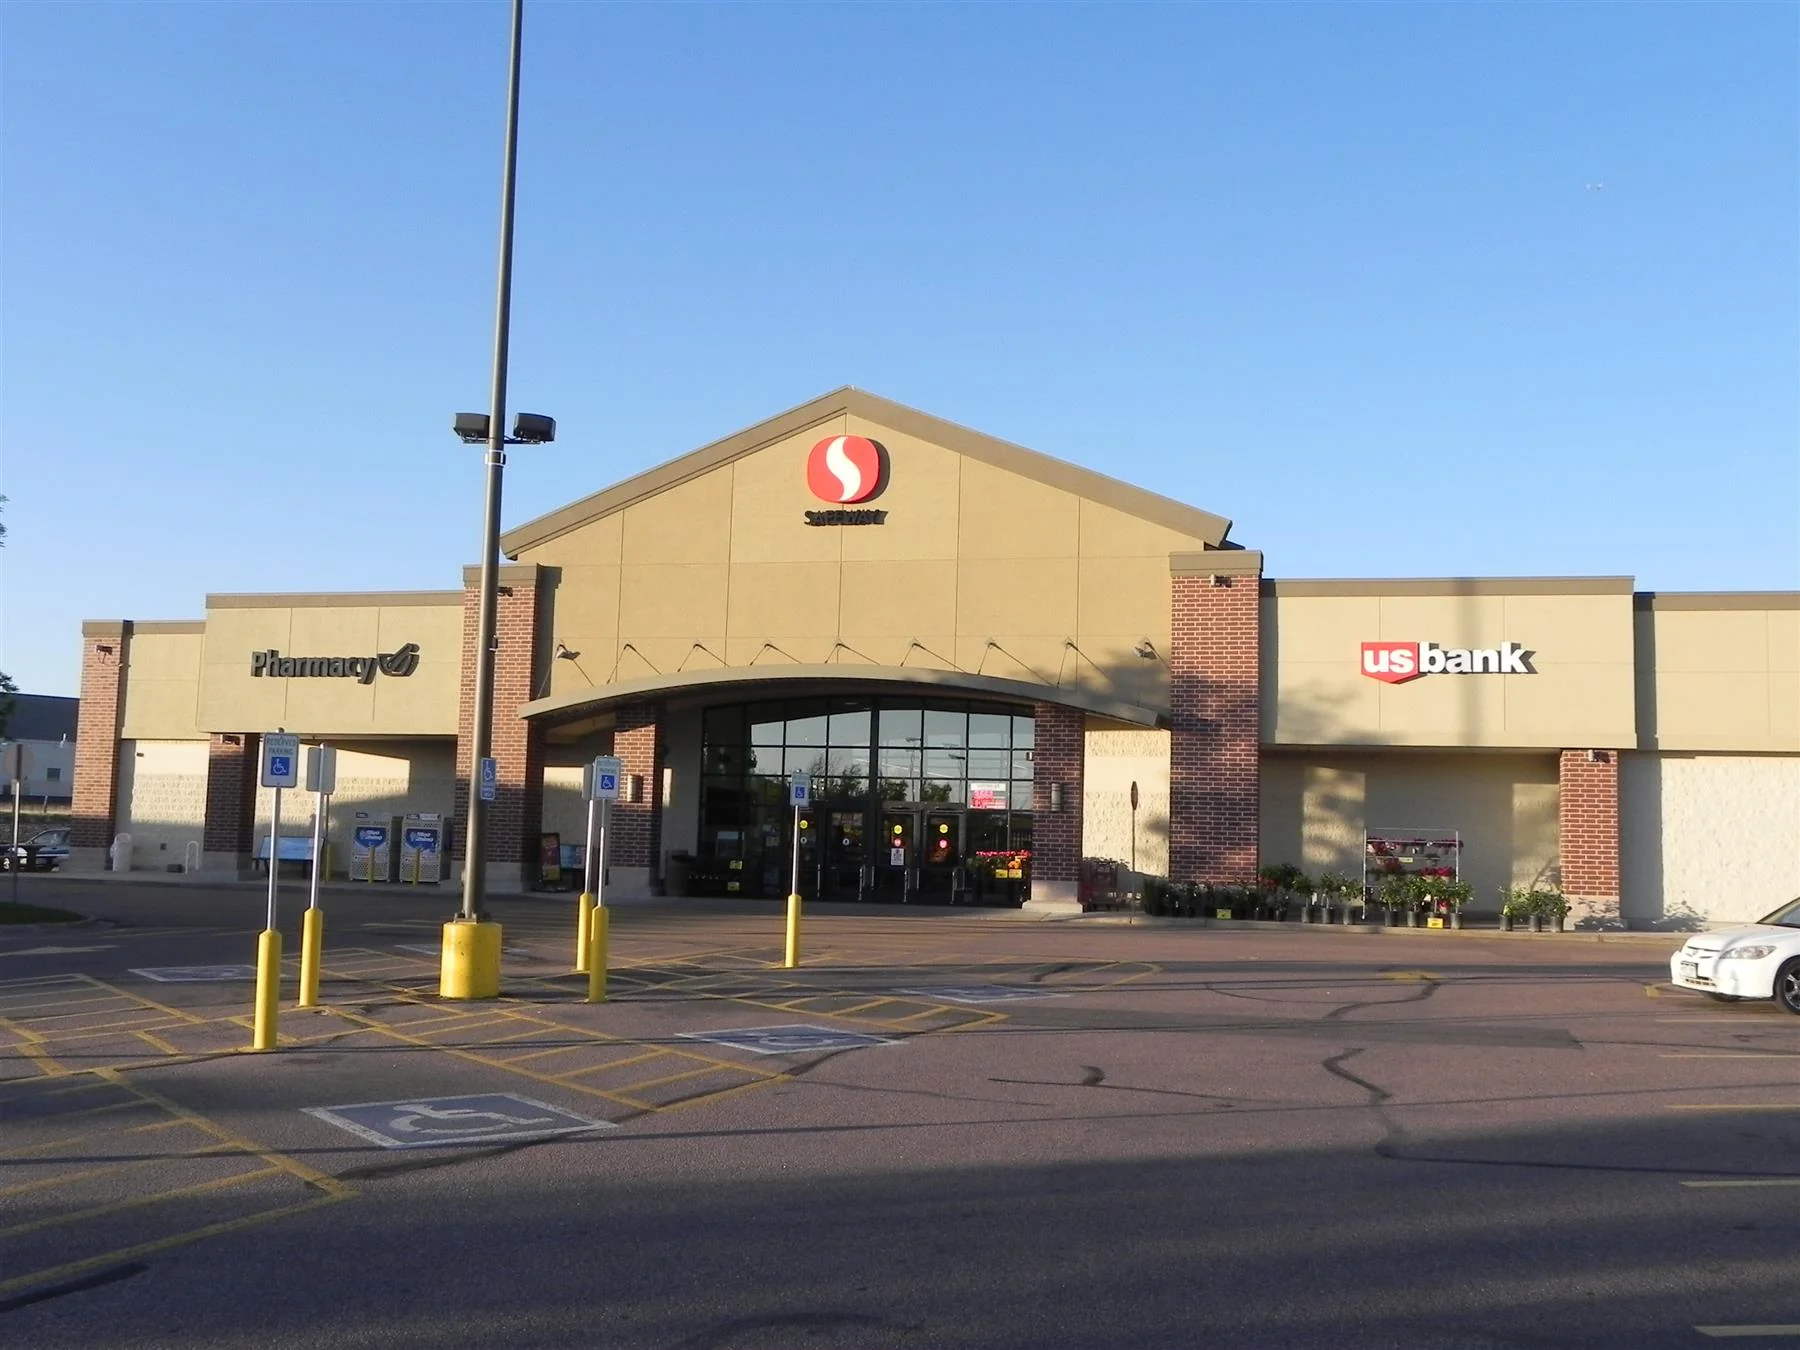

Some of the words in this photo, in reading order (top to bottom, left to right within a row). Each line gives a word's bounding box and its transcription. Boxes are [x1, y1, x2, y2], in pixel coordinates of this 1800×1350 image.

[804, 510, 888, 526] SAFEWAY
[252, 650, 377, 684] Pharmacy
[1364, 649, 1415, 674] us
[1418, 642, 1529, 675] bank
